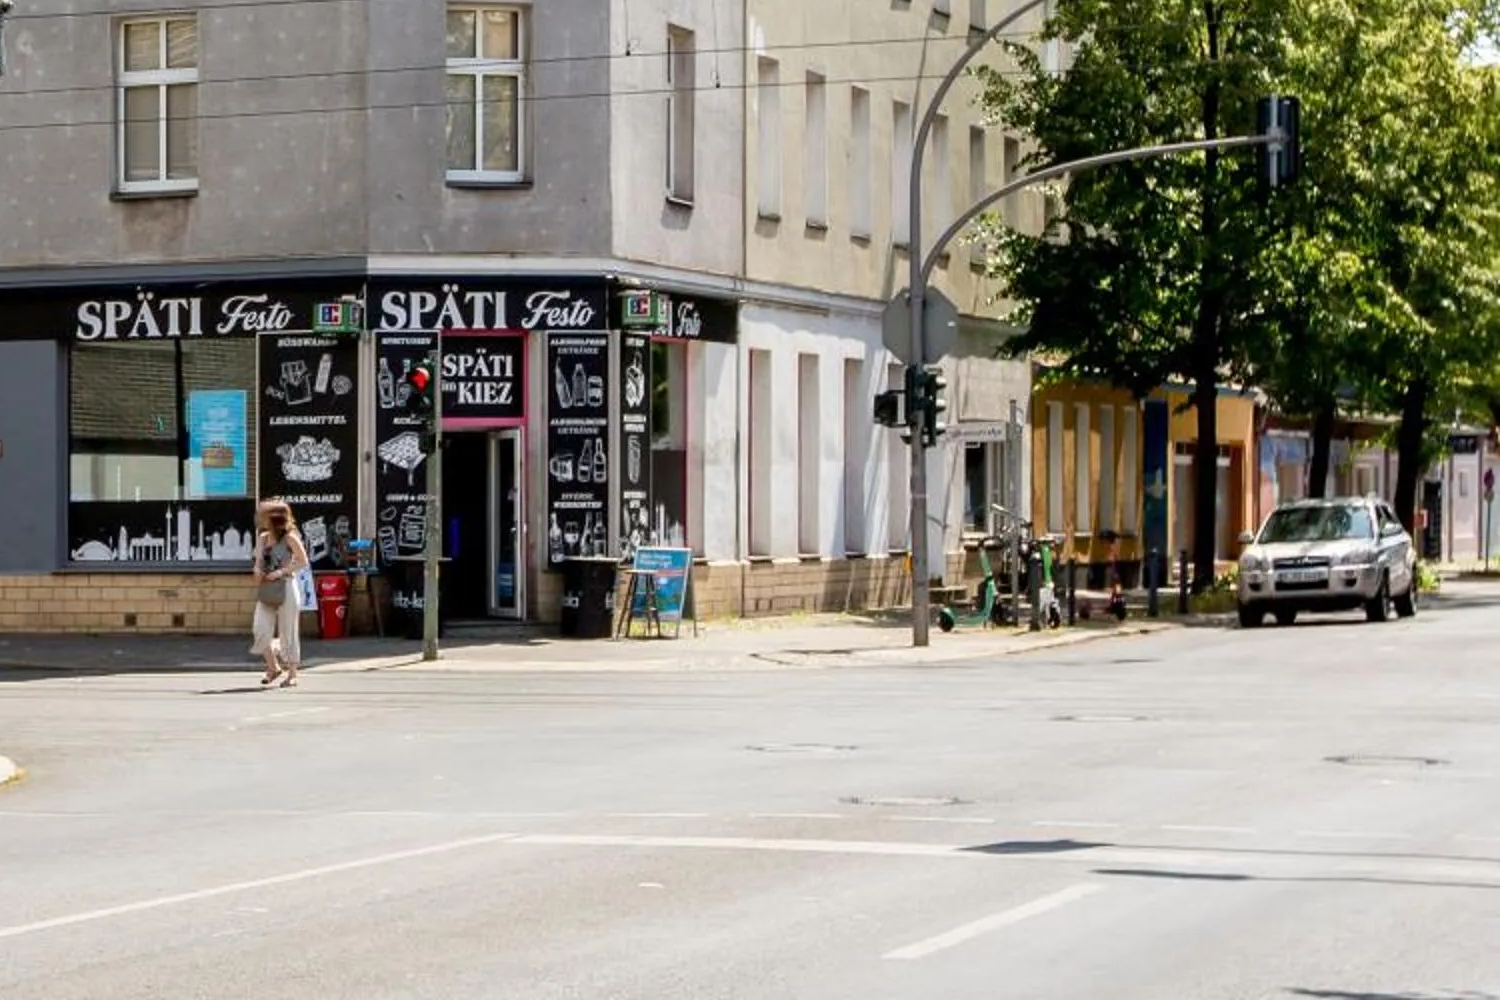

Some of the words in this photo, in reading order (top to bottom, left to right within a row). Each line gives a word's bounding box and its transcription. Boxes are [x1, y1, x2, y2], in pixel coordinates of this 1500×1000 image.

[76, 292, 203, 340] SPÄTI
[216, 294, 295, 334] Festo
[380, 284, 507, 329] SPÄTI
[521, 290, 597, 329] Festo
[442, 348, 514, 377] SPÄTI
[457, 381, 513, 405] KIEZ
[269, 415, 347, 425] LEBENSMITTEL
